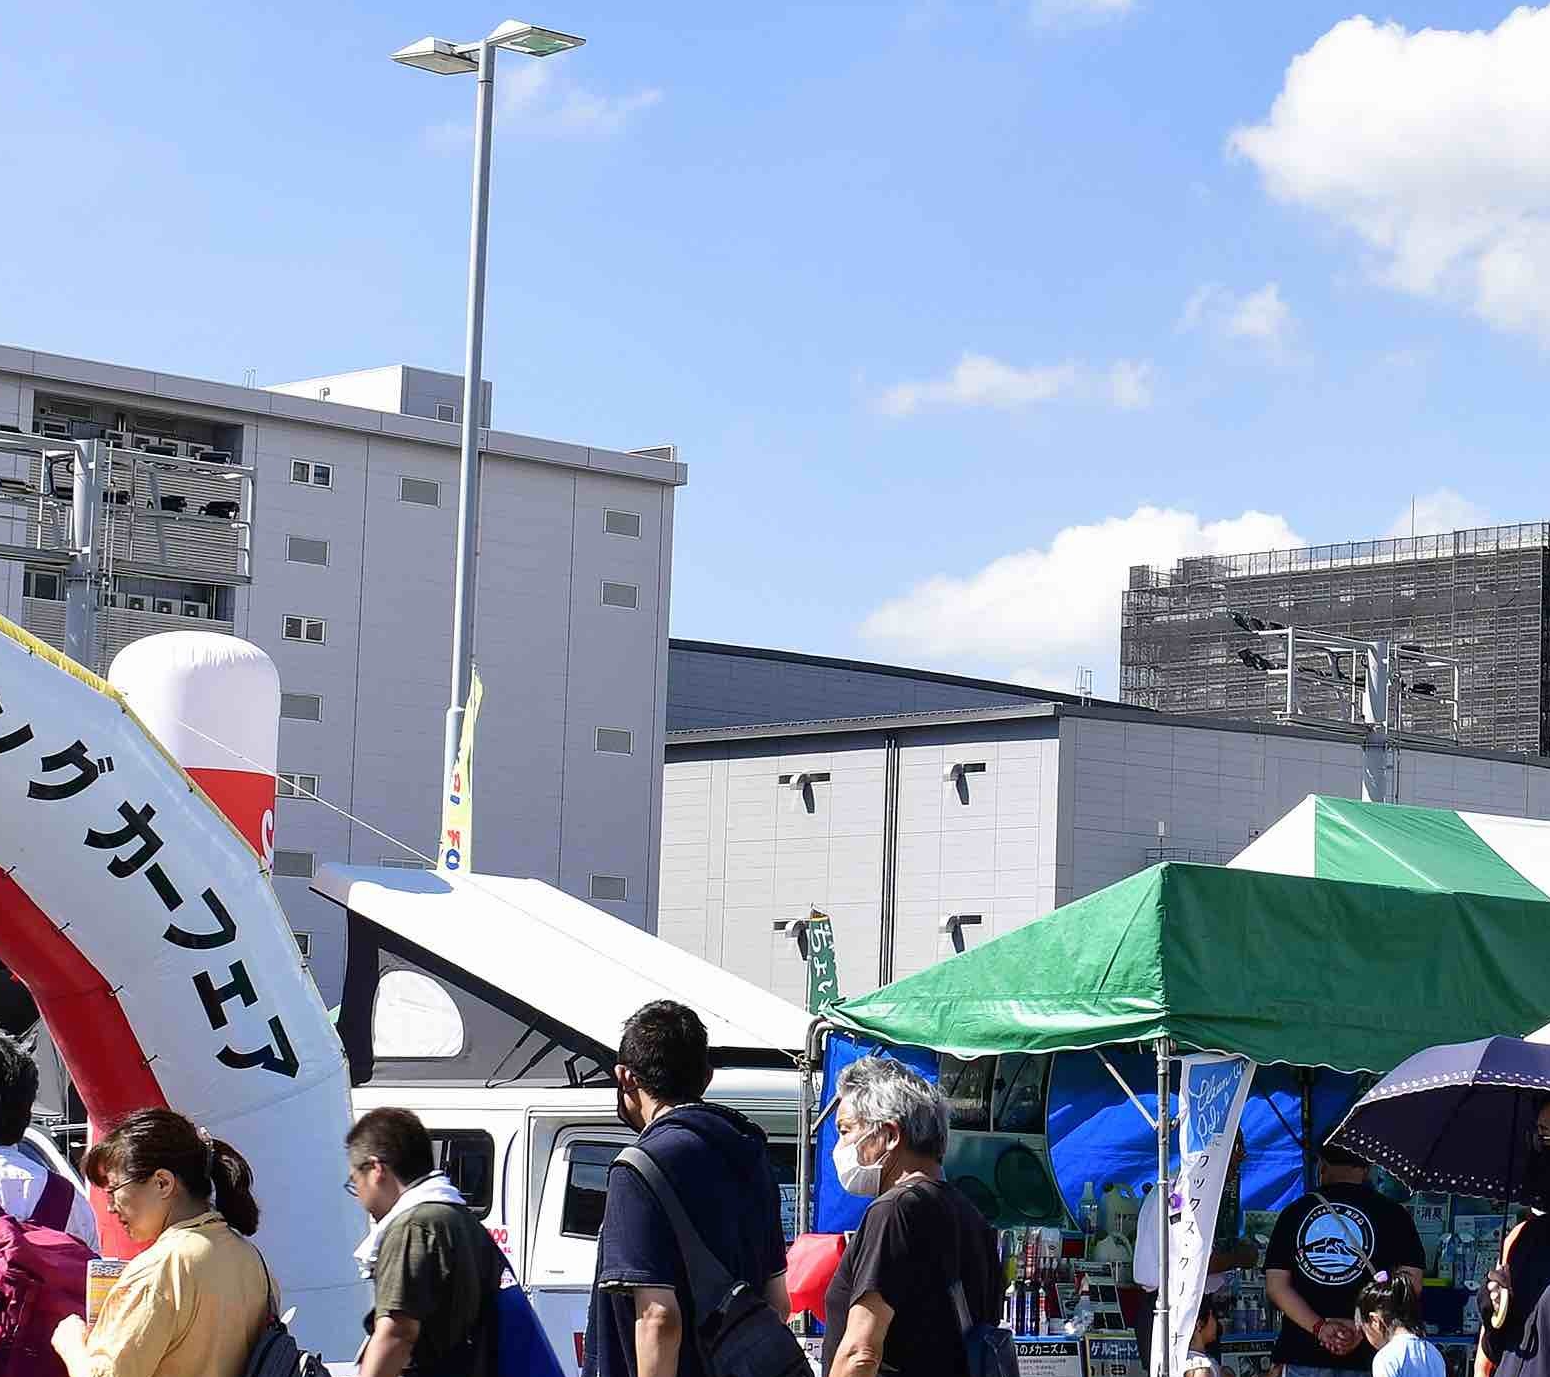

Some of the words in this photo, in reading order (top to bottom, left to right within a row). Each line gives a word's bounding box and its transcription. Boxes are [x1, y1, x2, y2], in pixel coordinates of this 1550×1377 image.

[1016, 1342, 1068, 1356] のメカニズム
[1090, 1340, 1139, 1357] ゲルコート
